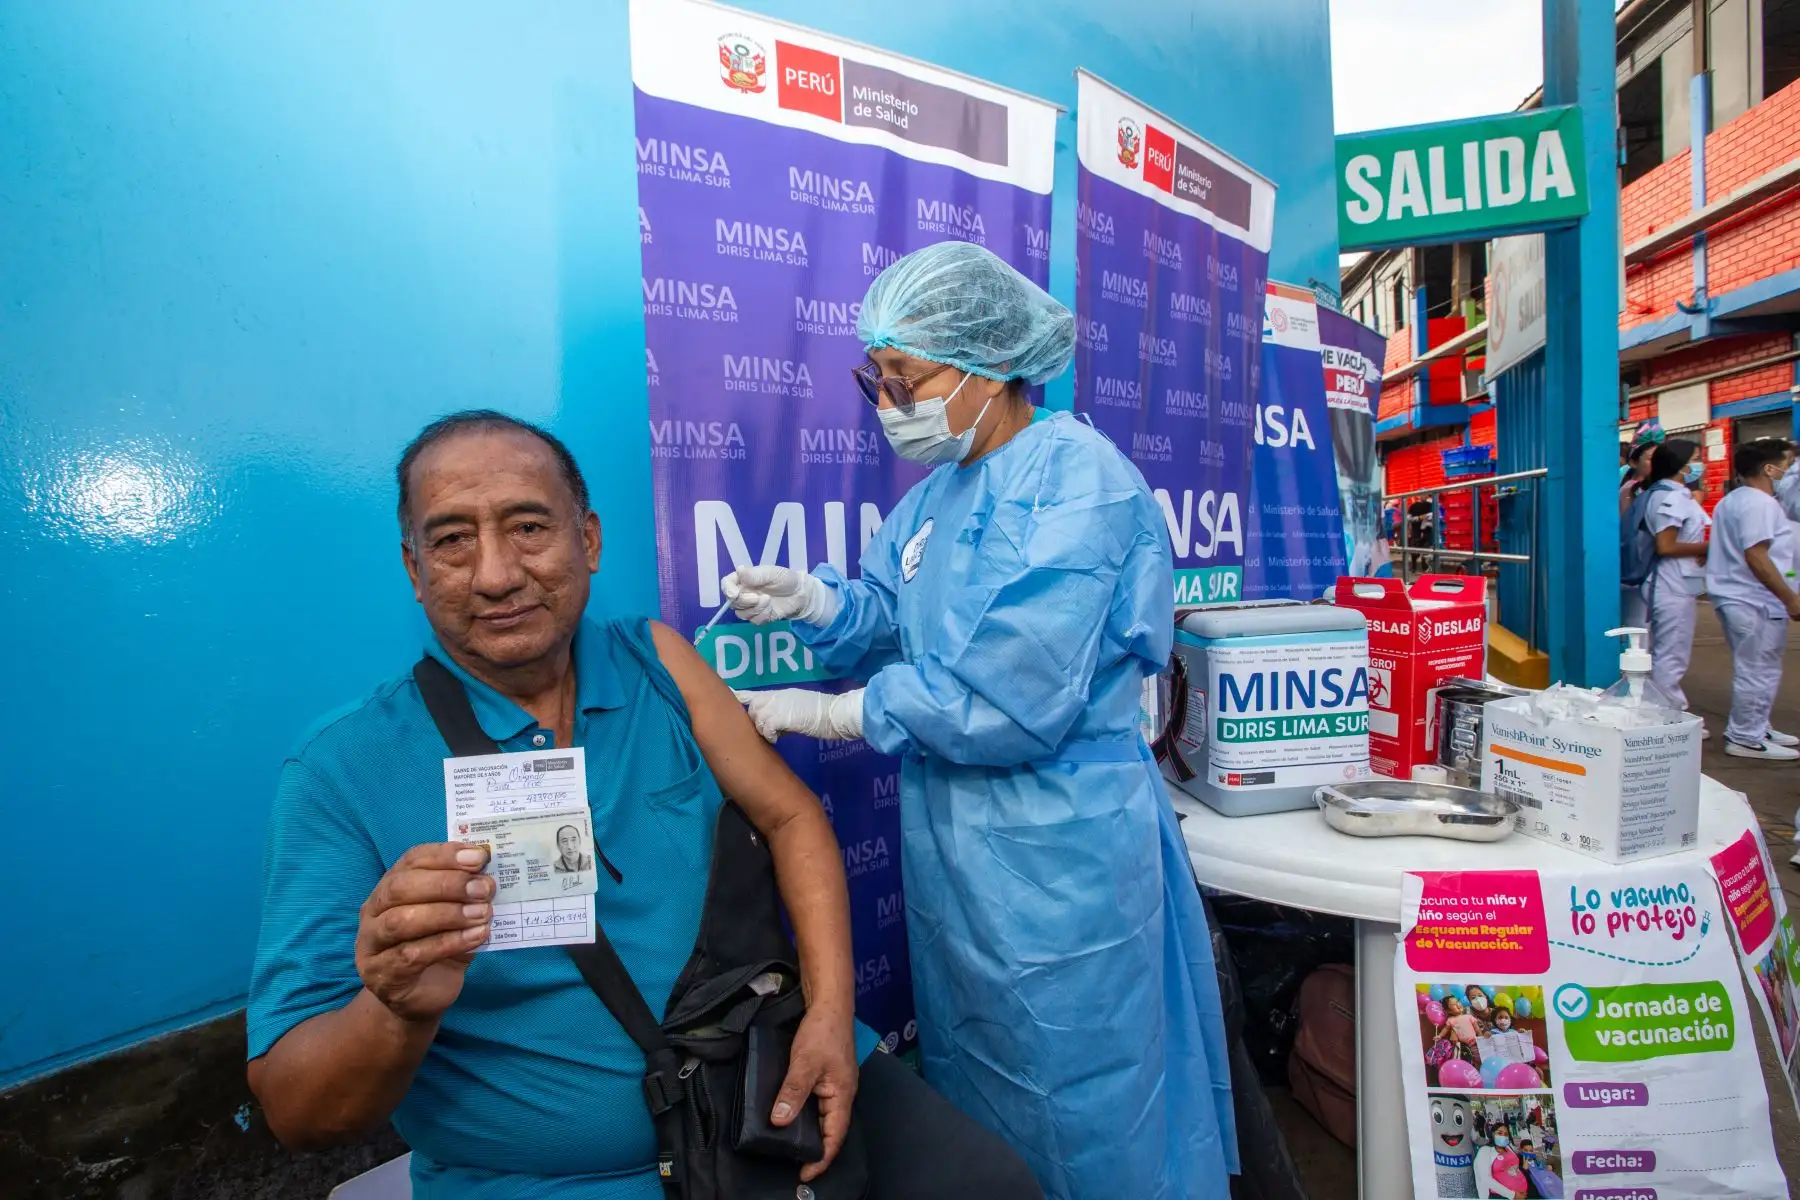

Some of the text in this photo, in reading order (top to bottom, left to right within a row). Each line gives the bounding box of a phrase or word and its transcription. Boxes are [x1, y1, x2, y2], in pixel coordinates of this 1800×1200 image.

[785, 69, 835, 96] PERÚ
[853, 85, 919, 115] Ministerio
[854, 102, 909, 129] de Salud
[636, 137, 730, 176] MINSA
[1148, 148, 1171, 172] PERÚ
[669, 167, 702, 183] LIMA
[706, 173, 731, 189] SUR
[789, 166, 874, 203] MINSA
[1178, 164, 1212, 189] Ministerio
[1345, 130, 1576, 225] SALIDA
[1177, 179, 1207, 199] de Salud
[790, 191, 875, 215] DIRIS LIMA SUR
[917, 198, 985, 235] MINSA
[716, 218, 808, 255] MINSA
[918, 220, 945, 233] DIRIS
[947, 225, 966, 239] LIMA
[717, 244, 809, 268] DIRIS LIMA SUR
[862, 242, 902, 268] MIN
[1144, 229, 1182, 260] MINSA
[642, 278, 737, 310] MINSA
[1103, 270, 1148, 298] MINSA
[676, 306, 709, 321] LIMA
[713, 310, 738, 323] SUR
[796, 297, 861, 325] MINS
[1171, 292, 1212, 318] MINSA
[796, 321, 857, 336] DIRIS LIMA
[723, 354, 813, 386] MINSA
[725, 379, 814, 398] DIRIS LIMA SUR
[1096, 376, 1142, 400] MINSA
[1336, 373, 1365, 395] PERÚ
[1166, 388, 1208, 408] MINSA
[1221, 400, 1251, 420] MINS
[648, 420, 745, 447] MINSA
[802, 429, 879, 454] MINSA
[1133, 432, 1172, 453] MINSA
[684, 447, 716, 460] LIMA
[720, 448, 746, 460] SUR
[801, 453, 880, 466] DIRIS LIMA SUR
[1263, 504, 1338, 516] Ministerio de Salud
[1154, 488, 1243, 558] NSA
[1268, 556, 1345, 567] Ministerio de Salud
[1209, 572, 1237, 601] SUR
[1366, 620, 1410, 636] ESLAB
[1434, 618, 1481, 637] DESLAB
[715, 631, 814, 679] DIRI
[1219, 667, 1369, 713] MINSA
[1223, 715, 1369, 740] DIRIS LIMA SUR
[818, 749, 843, 763] DIRIS
[1552, 737, 1602, 759] Syringe
[1580, 835, 1590, 845] 100
[870, 858, 889, 872] SUR
[1420, 894, 1527, 908] acuna a tu niña y
[1570, 882, 1696, 912] Lo vacuno,
[1446, 910, 1482, 923] según
[1486, 910, 1496, 920] el
[1571, 905, 1696, 940] lo protejo
[1416, 924, 1533, 938] Esquema Regular
[1416, 938, 1523, 950] de Vacunación.
[1595, 993, 1722, 1019] Jornada de
[1596, 1018, 1729, 1046] vacunación
[1579, 1087, 1635, 1103] Lugar:
[1436, 1155, 1471, 1166] MINSA
[1585, 1154, 1643, 1168] Fecha:
